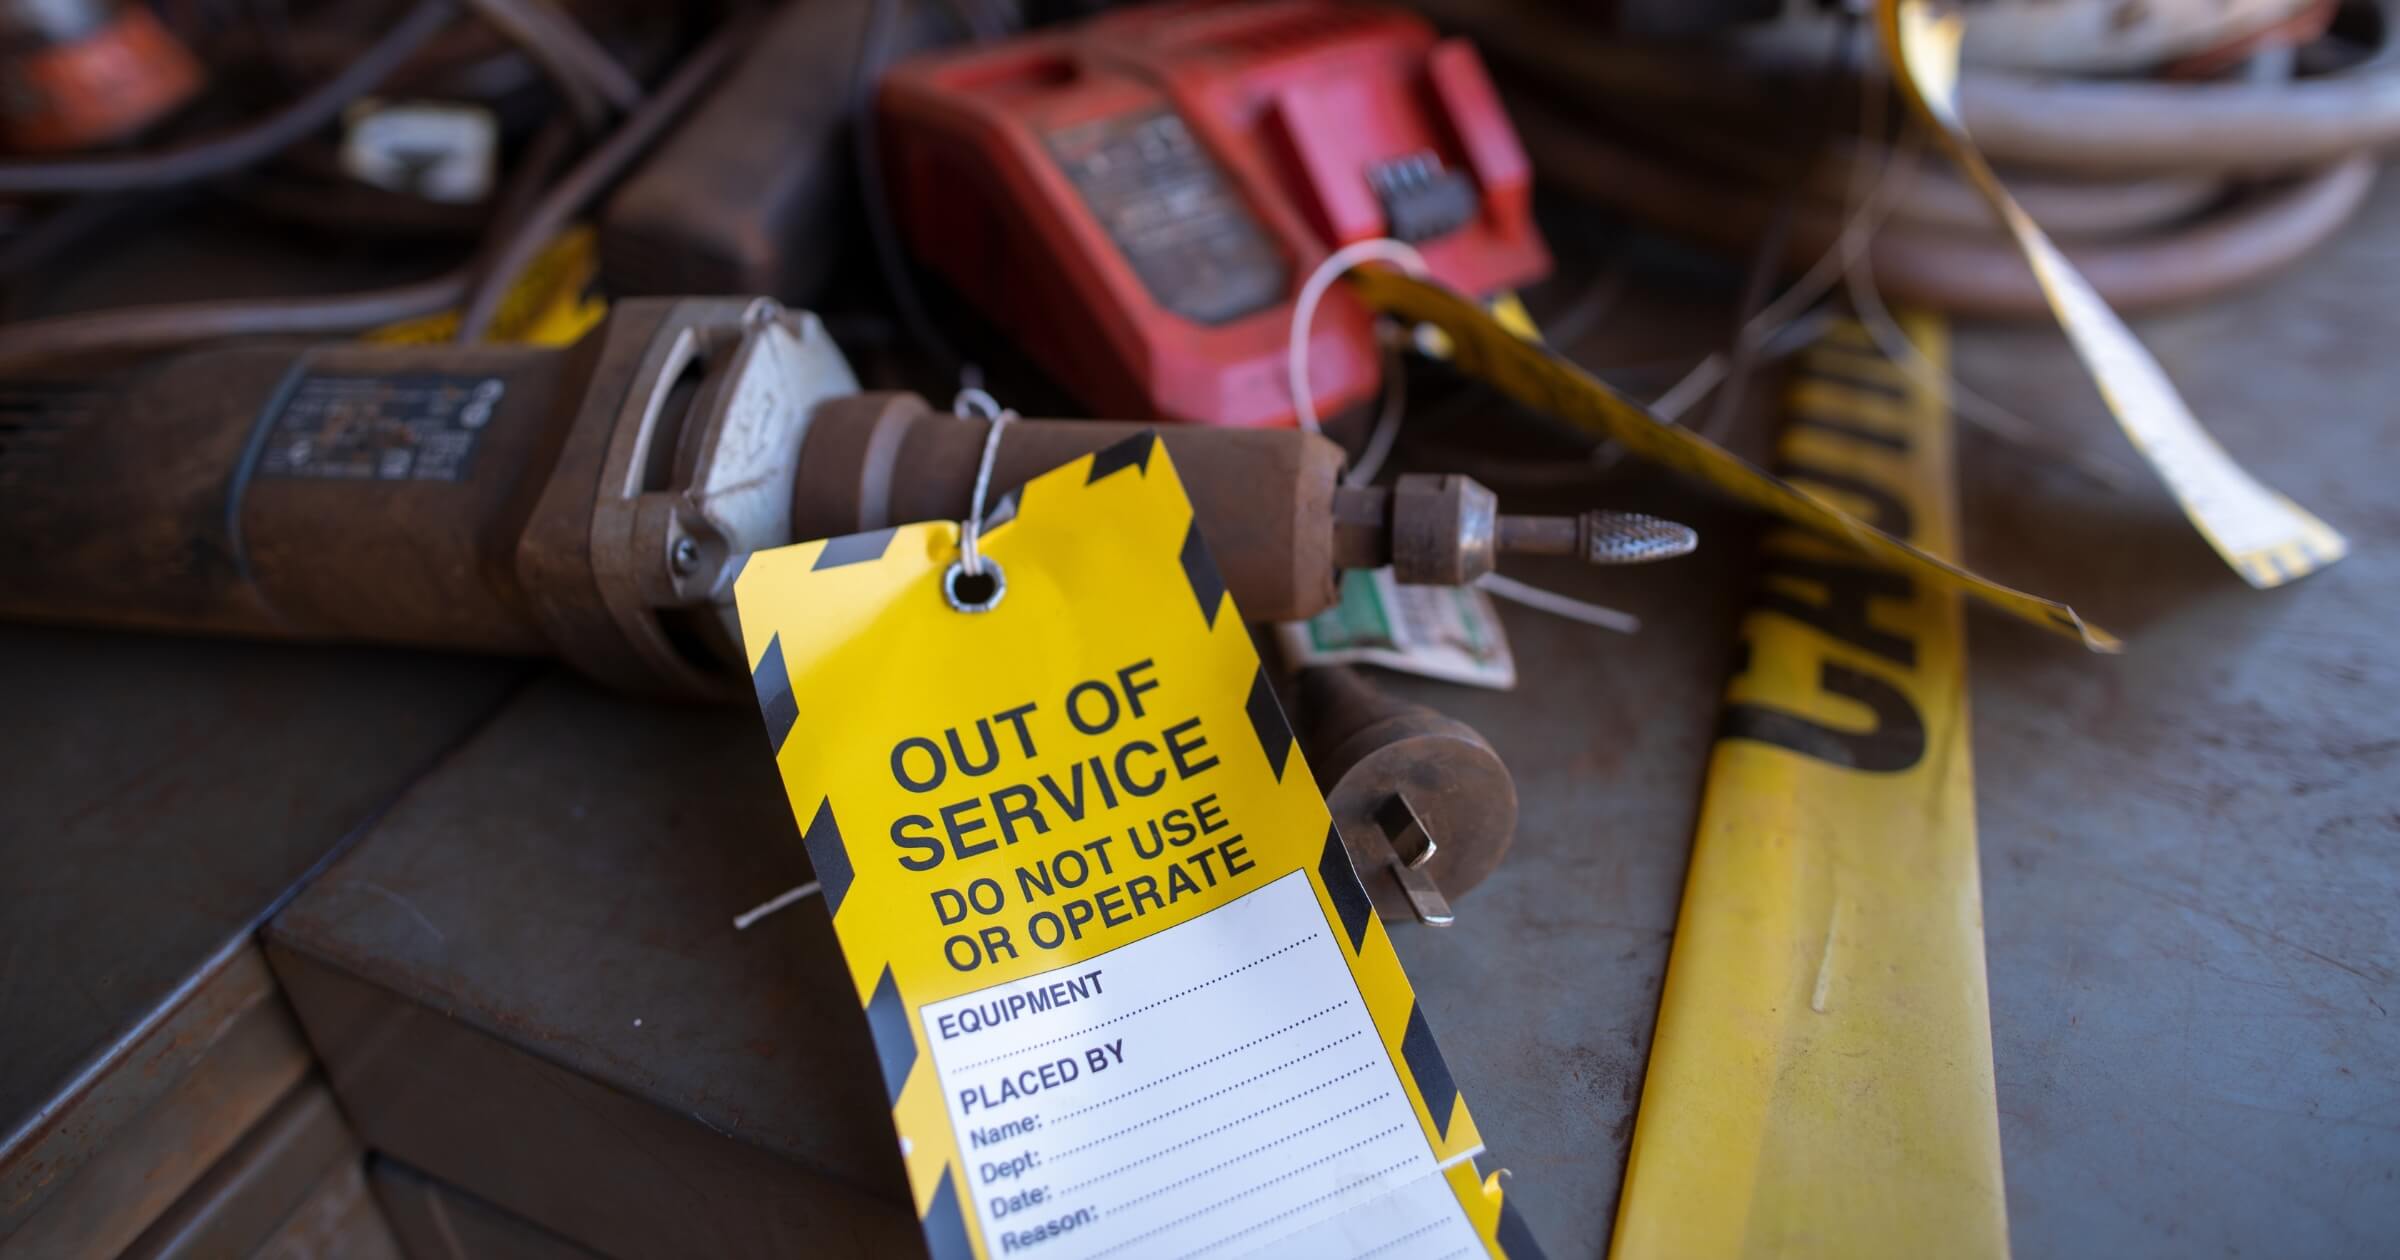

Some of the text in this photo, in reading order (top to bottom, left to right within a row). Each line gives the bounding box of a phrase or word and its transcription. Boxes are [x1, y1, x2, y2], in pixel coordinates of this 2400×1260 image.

[890, 658, 1160, 794] OUT OF
[889, 716, 1220, 872] SERVICE
[930, 793, 1230, 926] DO NOT USE
[943, 833, 1257, 972] OR OPERATE
[937, 970, 1104, 1040] EQUIPMENT
[959, 1038, 1126, 1116] PLACED BY
[969, 1113, 1043, 1150] Name:
[979, 1150, 1043, 1184] Dept:
[989, 1184, 1053, 1220] Date:
[1000, 1204, 1100, 1254] Reason:
